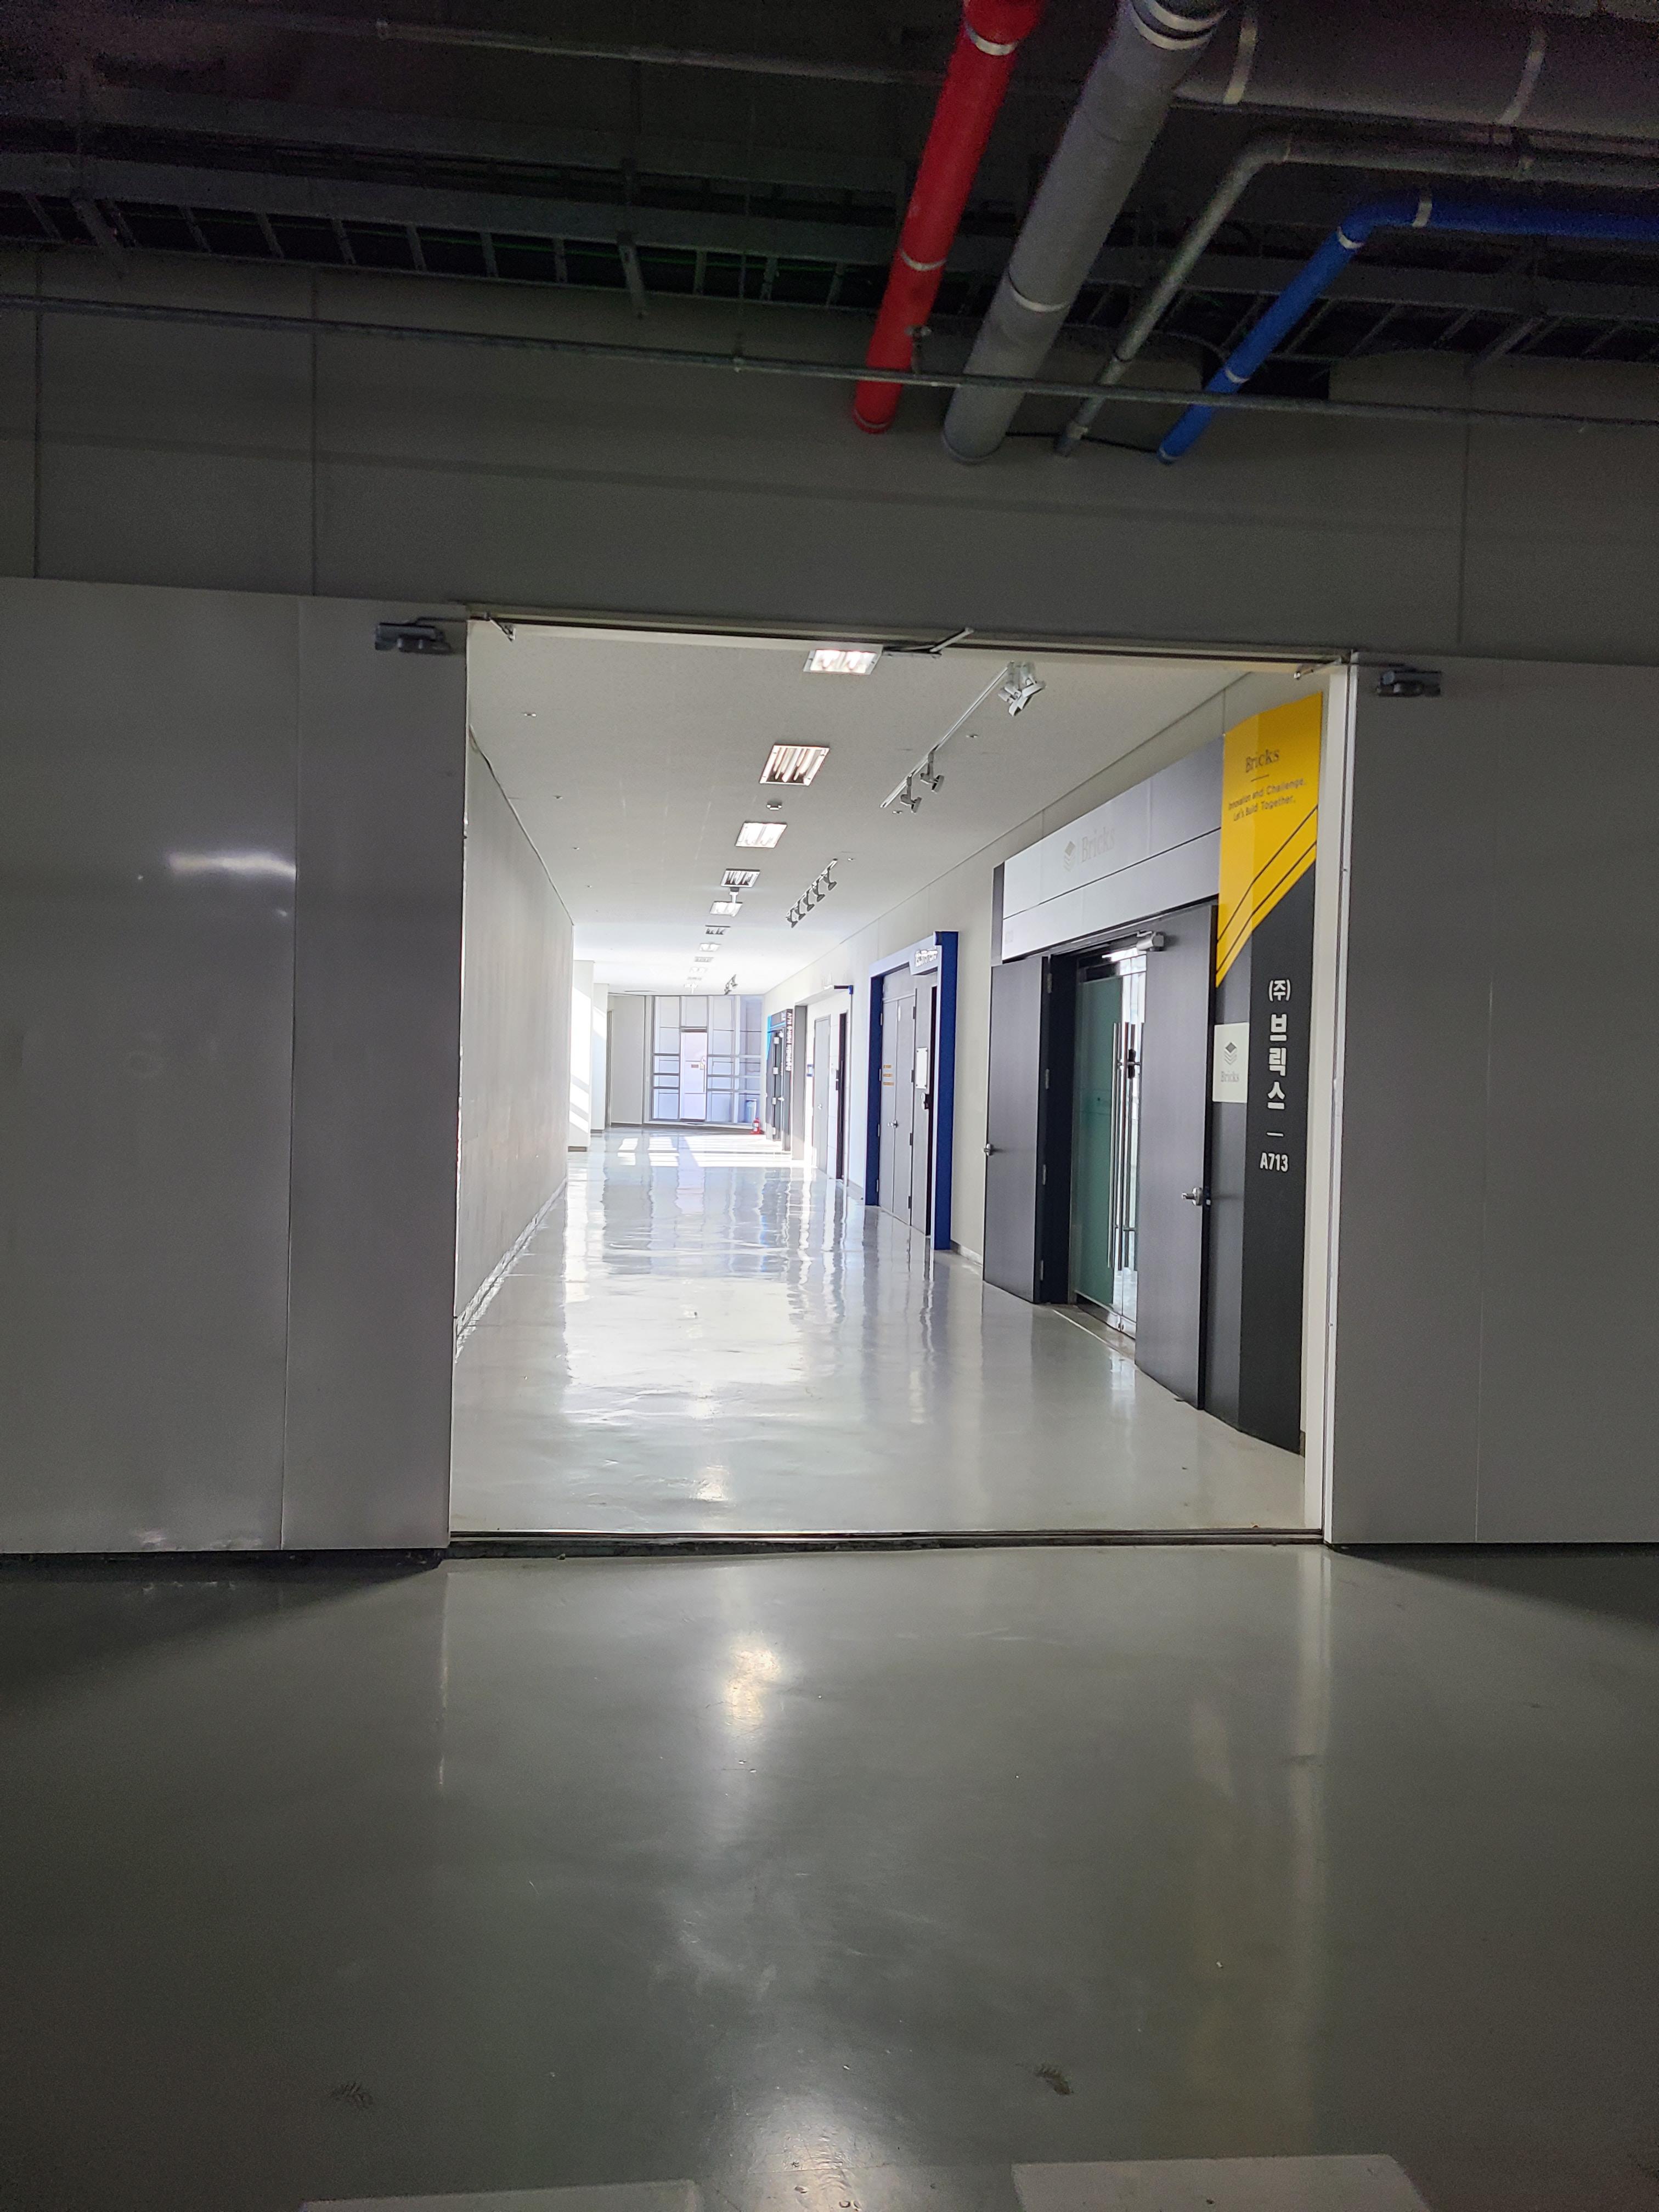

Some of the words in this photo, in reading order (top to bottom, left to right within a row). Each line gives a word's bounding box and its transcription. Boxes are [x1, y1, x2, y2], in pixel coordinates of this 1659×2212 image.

[1245, 749, 1279, 772] Bricks
[1082, 826, 1115, 862] Bricks
[1221, 1071, 1239, 1083] Bricks
[1260, 1152, 1289, 1172] A713
